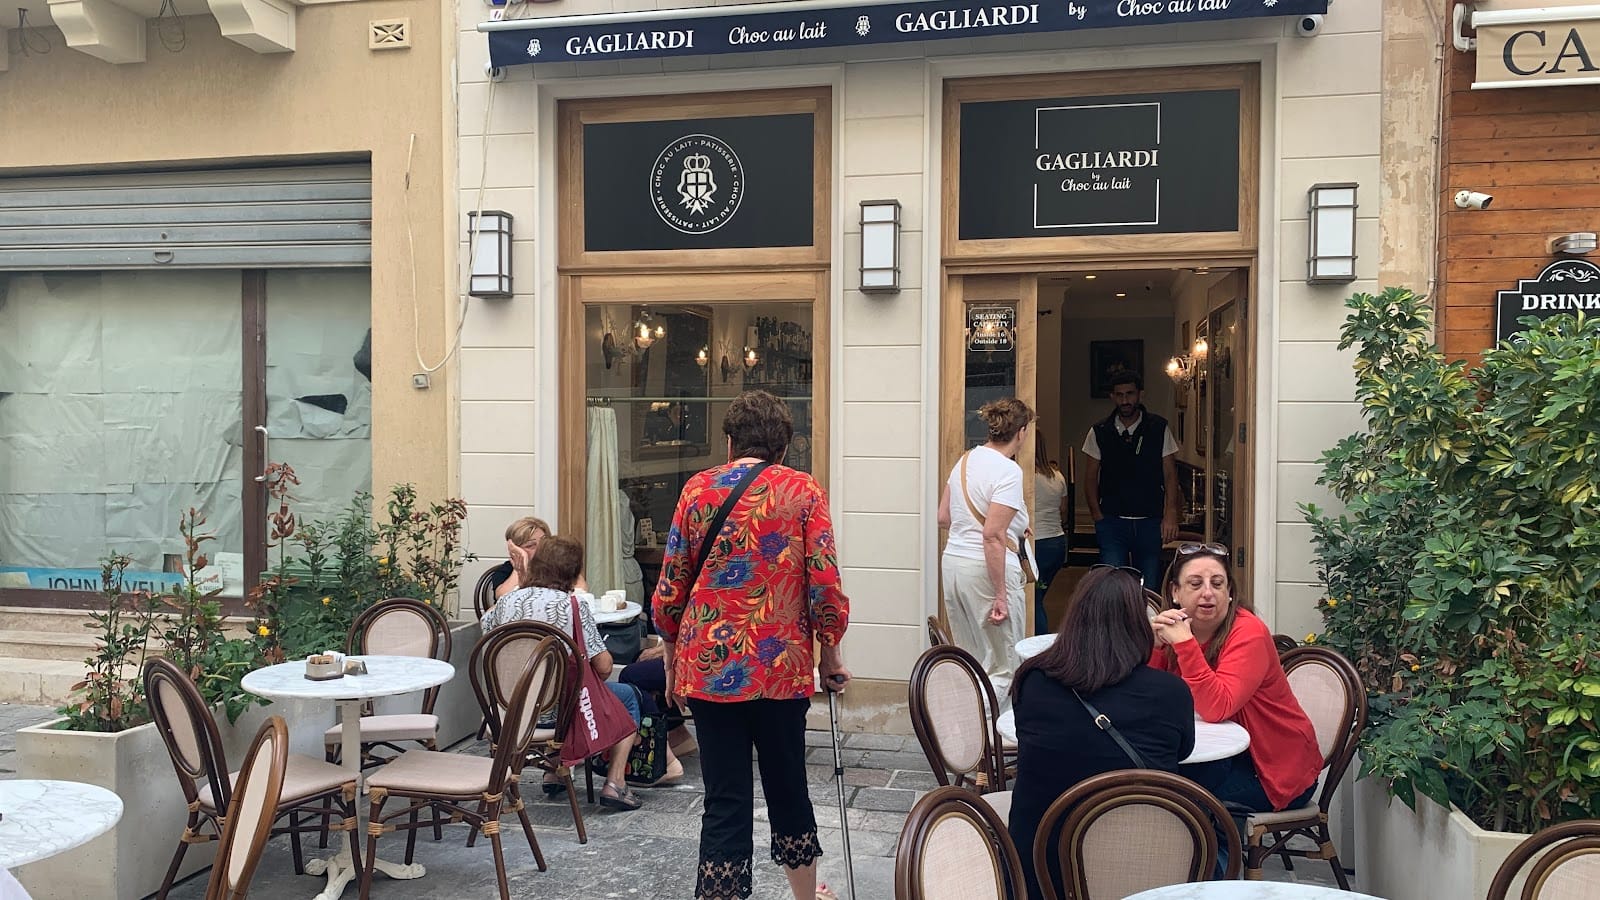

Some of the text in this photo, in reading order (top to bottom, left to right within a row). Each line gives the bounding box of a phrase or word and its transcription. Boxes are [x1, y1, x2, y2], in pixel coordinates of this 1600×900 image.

[565, 30, 694, 56] GAGLIARDI
[728, 26, 770, 46] Choc
[773, 28, 797, 43] au
[798, 21, 828, 40] lait
[895, 3, 1040, 34] GAGLIARDI
[1068, 1, 1087, 21] by
[1116, 0, 1164, 17] Choc
[1503, 27, 1600, 76] CA
[655, 163, 666, 188] CHOC
[664, 150, 674, 163] AU
[674, 140, 693, 152] LAIT
[1035, 149, 1159, 171] GAGLIARDI
[1091, 172, 1100, 181] by
[1061, 177, 1132, 192] Choc au lait
